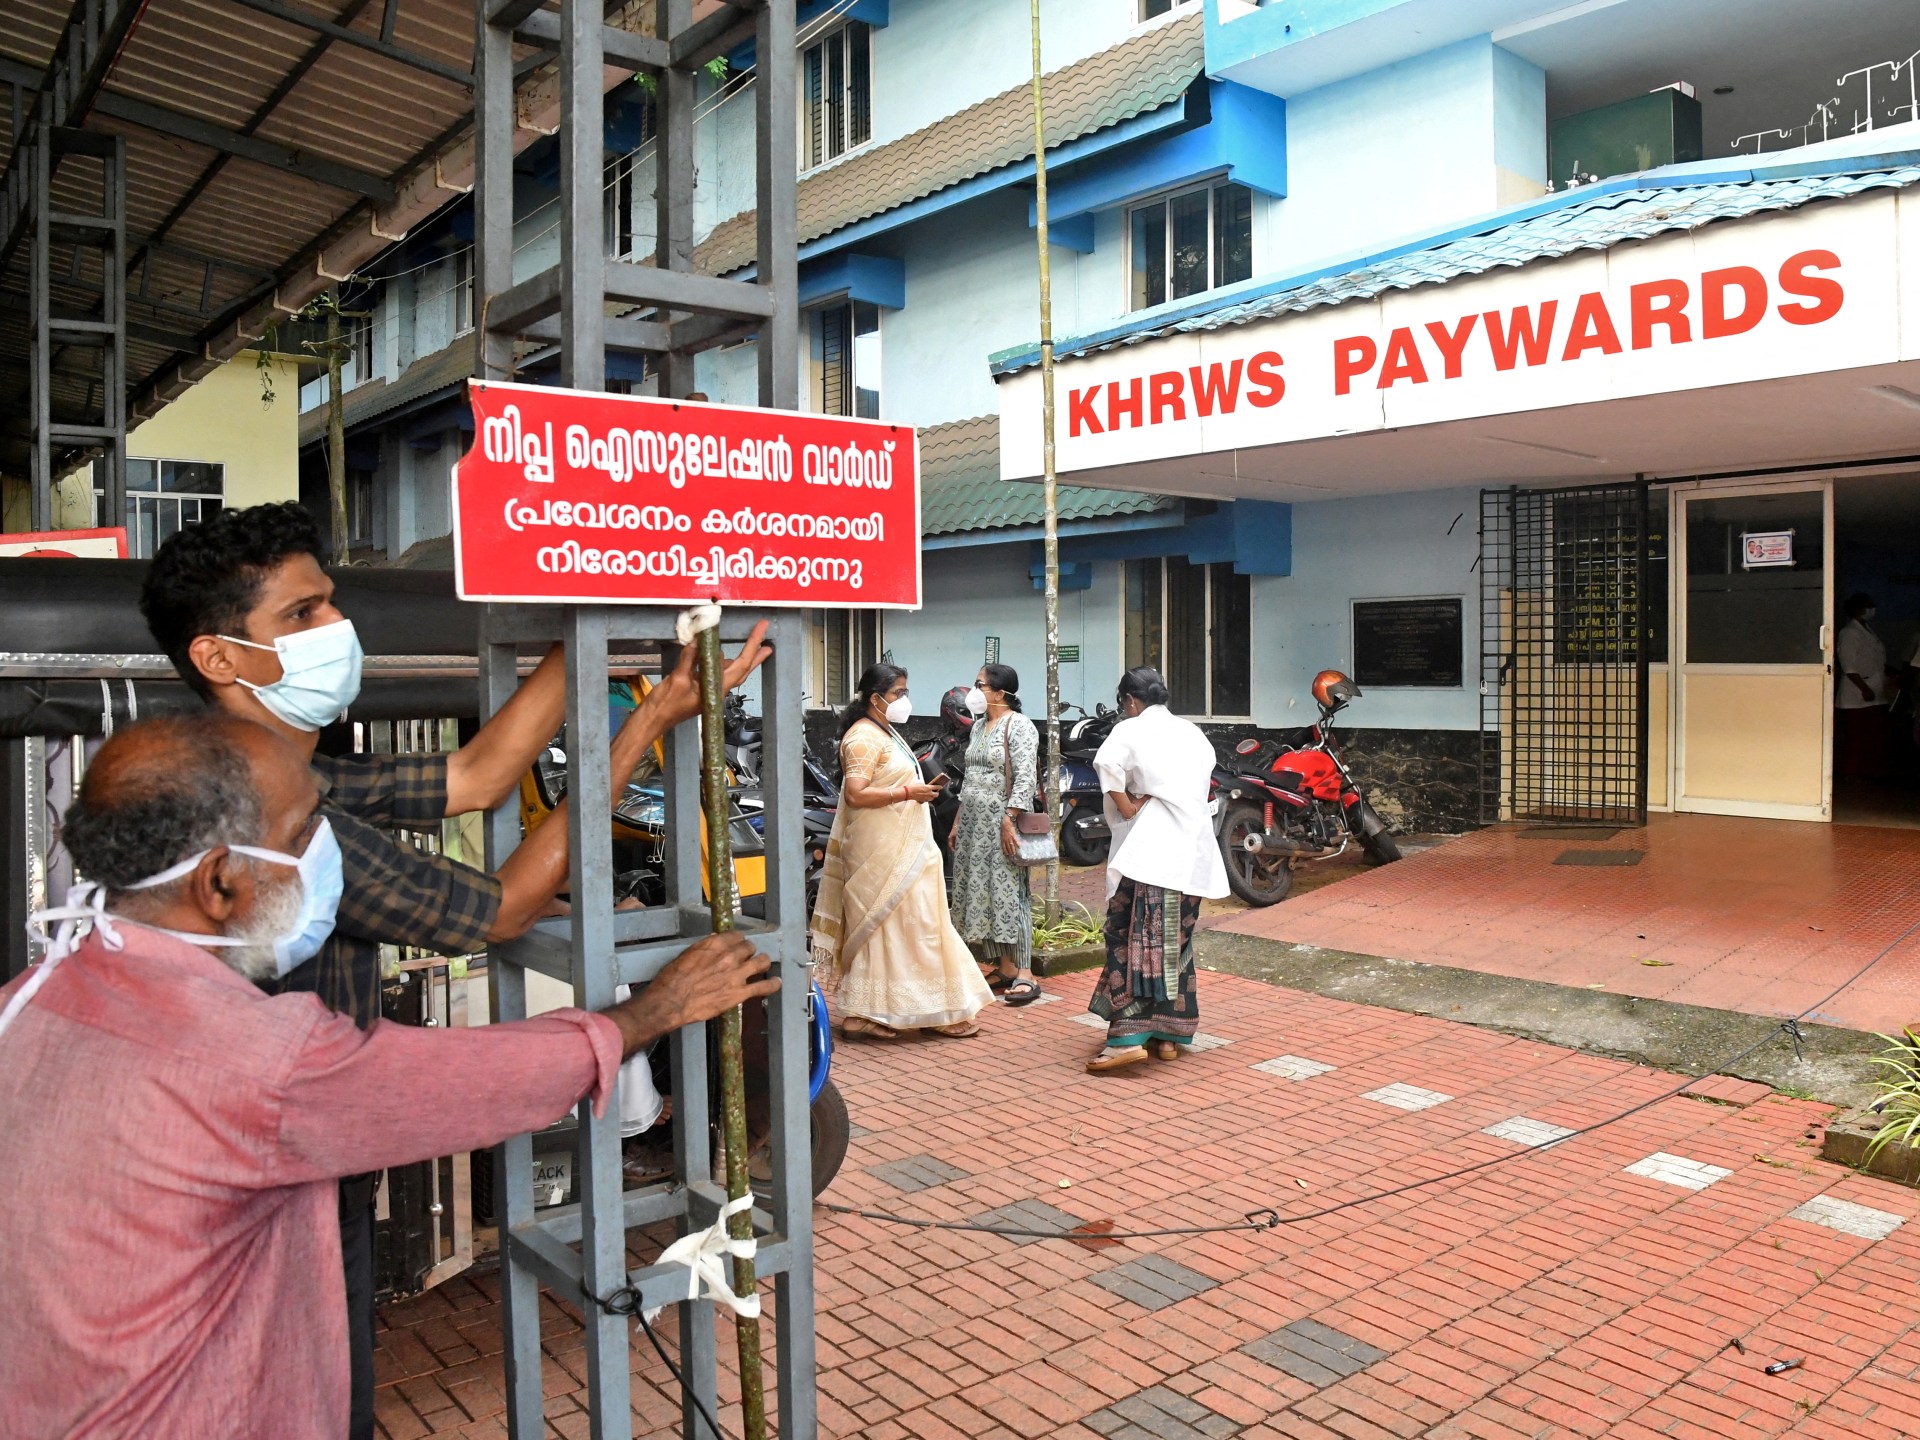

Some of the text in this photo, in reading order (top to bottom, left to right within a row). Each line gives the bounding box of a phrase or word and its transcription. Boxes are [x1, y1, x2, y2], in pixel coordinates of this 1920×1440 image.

[1070, 249, 1844, 437] KHRWS PAYWARDS
[483, 404, 555, 484] നിപ്പ
[803, 440, 896, 490] വാർഡ്
[504, 498, 884, 542] പ്രവേശനം കർശനമായി
[536, 539, 863, 589] നിരോധിച്ചിരിക്കുന്നു
[986, 638, 995, 665] ARKING
[533, 1165, 565, 1181] ACK
